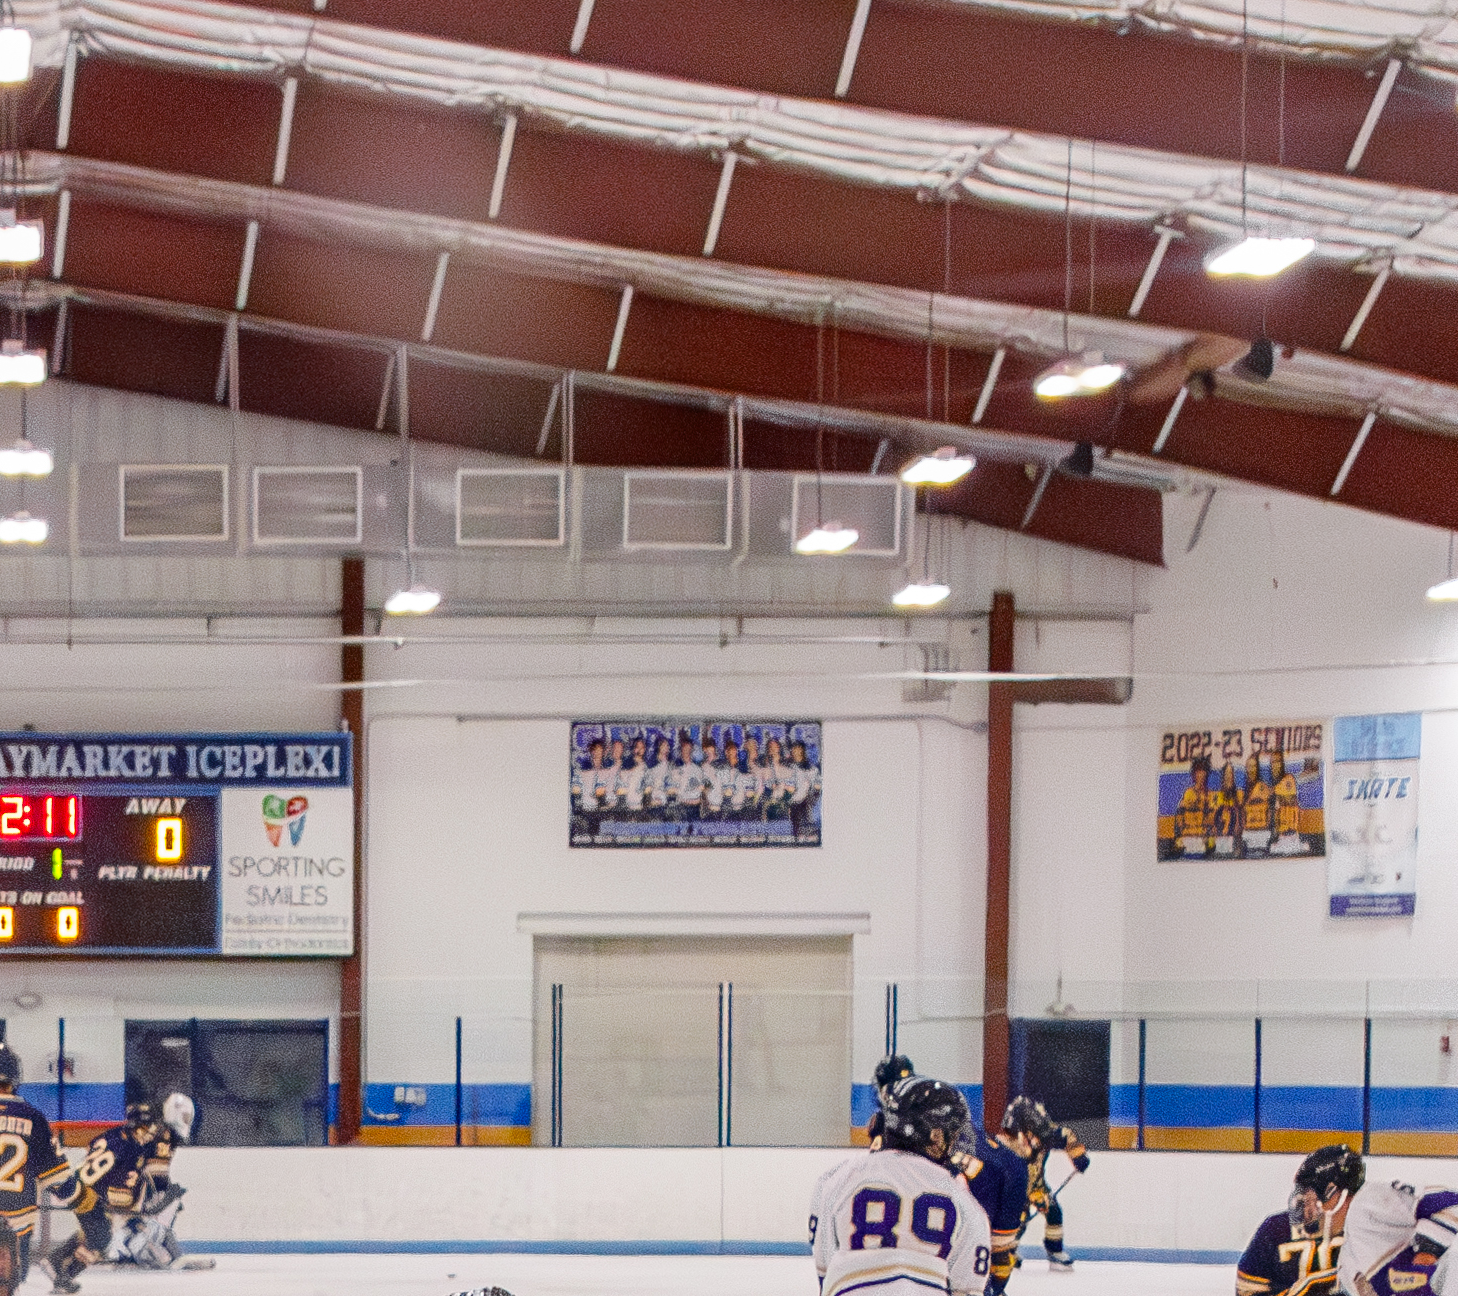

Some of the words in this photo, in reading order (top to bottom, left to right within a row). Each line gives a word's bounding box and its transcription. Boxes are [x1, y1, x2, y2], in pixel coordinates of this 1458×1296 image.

[1161, 728, 1243, 764] 2022-23
[1250, 723, 1324, 756] SENIORS
[0, 794, 76, 836] 2:11
[125, 797, 186, 816] AWAY
[156, 817, 183, 860] 0
[51, 847, 63, 880] 1
[142, 866, 210, 880] PENALTY
[228, 856, 345, 877] SPORTING
[22, 891, 43, 905] ON
[46, 891, 85, 905] GOAL
[246, 885, 328, 906] SMILES
[57, 906, 79, 939] 0
[850, 1187, 958, 1260] 89
[973, 1246, 990, 1276] 8
